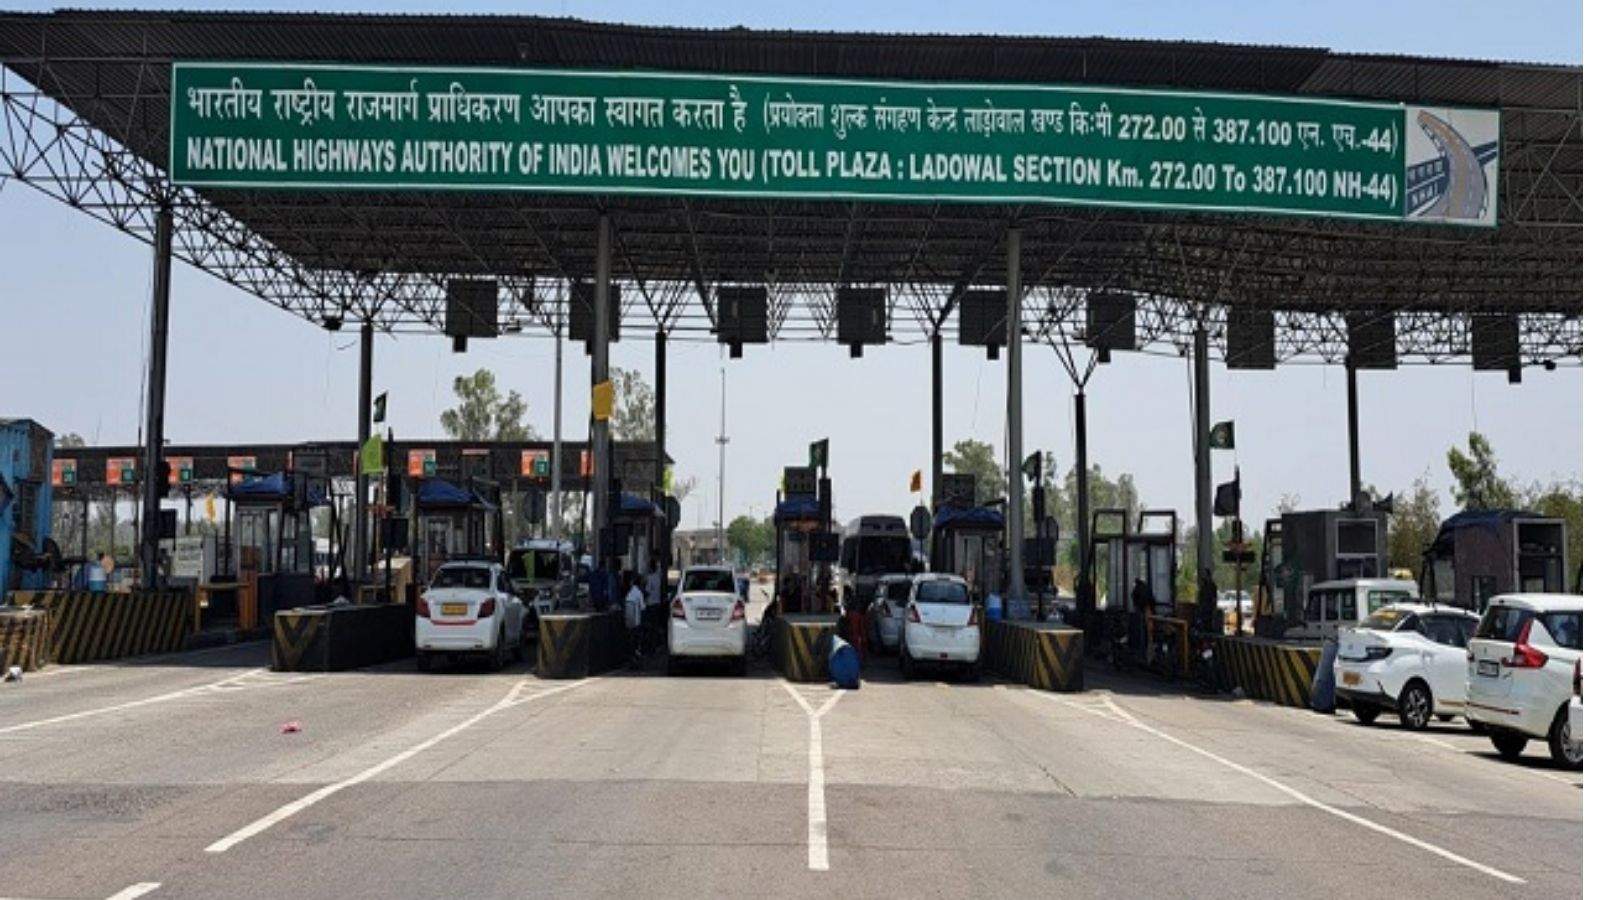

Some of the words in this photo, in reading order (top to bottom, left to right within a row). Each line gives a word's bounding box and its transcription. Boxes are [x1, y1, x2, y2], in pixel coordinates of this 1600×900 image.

[187, 77, 262, 119] भारतीय
[270, 77, 335, 126] राष्ट्रीय
[343, 79, 418, 121] राजमार्ग
[427, 82, 521, 124] प्राधिकरण
[531, 94, 596, 126] आपका
[603, 96, 664, 128] स्वागत
[671, 98, 725, 130] करता
[729, 85, 748, 132] है
[830, 103, 869, 139] शुल्क
[1031, 108, 1064, 133] खण्ड
[1117, 114, 1186, 141] 272.00
[1192, 106, 1207, 141] से
[1213, 118, 1292, 146] 387.100
[187, 136, 287, 171] NATIONAL
[294, 138, 396, 172] HIGHWAYS
[400, 140, 513, 174] AUTHORITY
[519, 141, 543, 175] OF
[548, 143, 602, 177] INDIA
[607, 144, 712, 180] WELCOMES
[717, 148, 755, 181] YOU
[761, 149, 820, 184] (TOLL
[827, 151, 892, 180] PLAZA
[897, 160, 904, 180] :
[909, 153, 1008, 182] LADOWAL
[1013, 154, 1102, 186] SECTION
[1107, 158, 1144, 188] Km.
[1150, 160, 1216, 191] 272.00
[1222, 164, 1246, 192] To
[1253, 164, 1328, 197] 387.100
[1333, 170, 1398, 208] NH-44)
